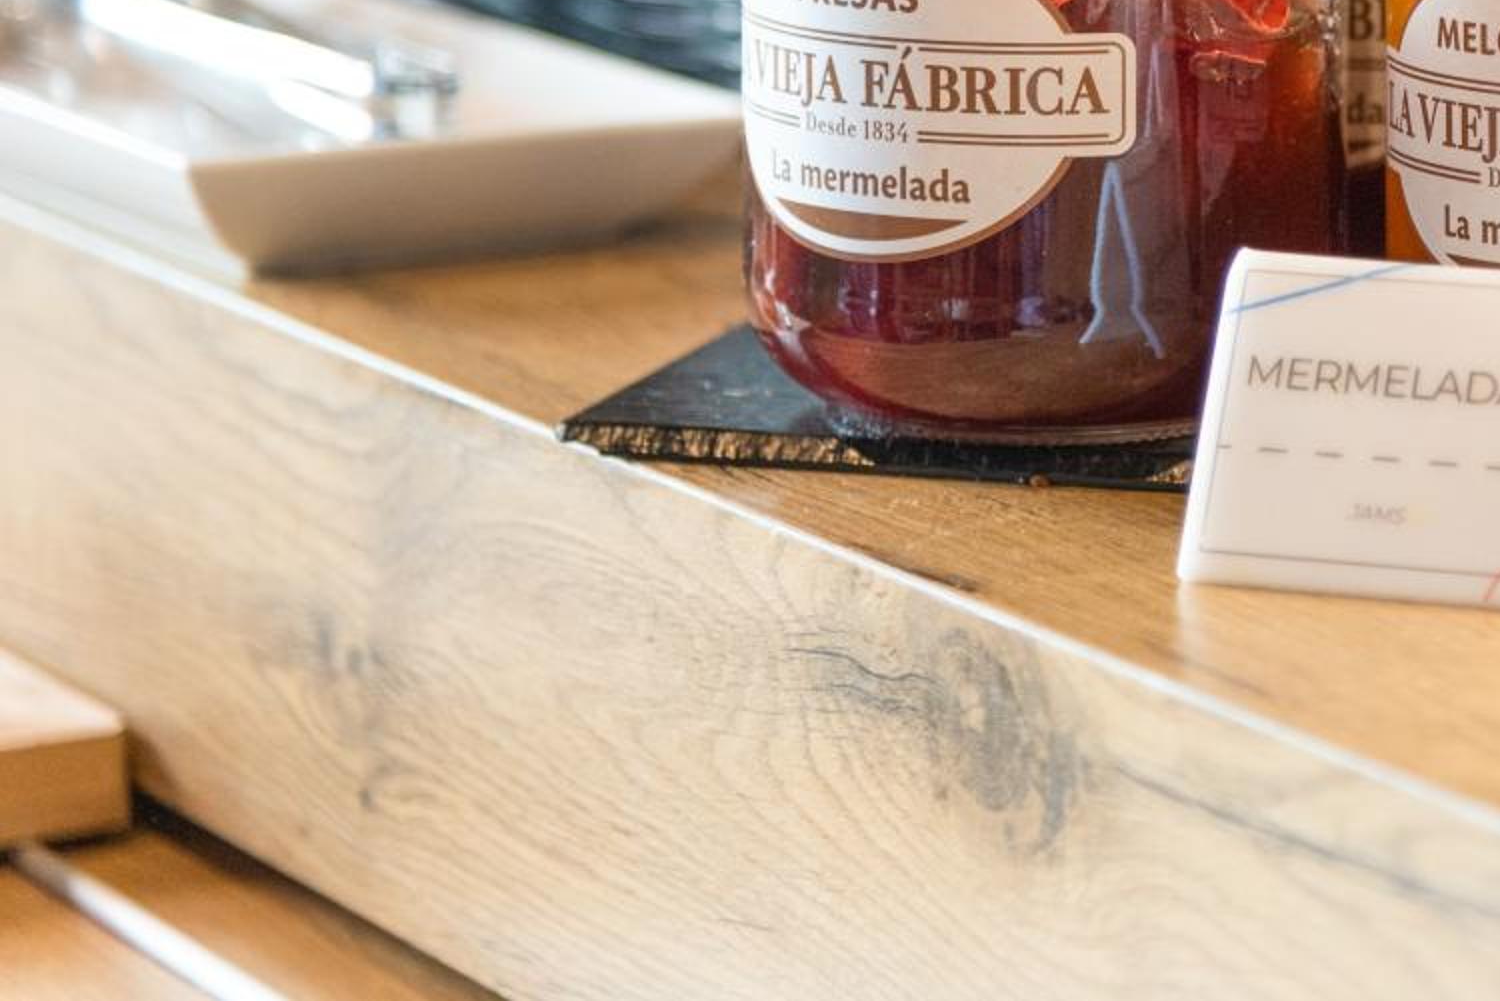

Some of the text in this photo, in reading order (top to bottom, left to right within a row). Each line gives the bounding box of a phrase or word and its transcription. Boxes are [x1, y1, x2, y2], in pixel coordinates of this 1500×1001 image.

[755, 38, 1110, 116] VIEJA FÁBRICA
[805, 111, 909, 143] Desde 1834
[1389, 80, 1416, 139] LA
[773, 149, 971, 204] La mermelada
[1443, 205, 1471, 241] La
